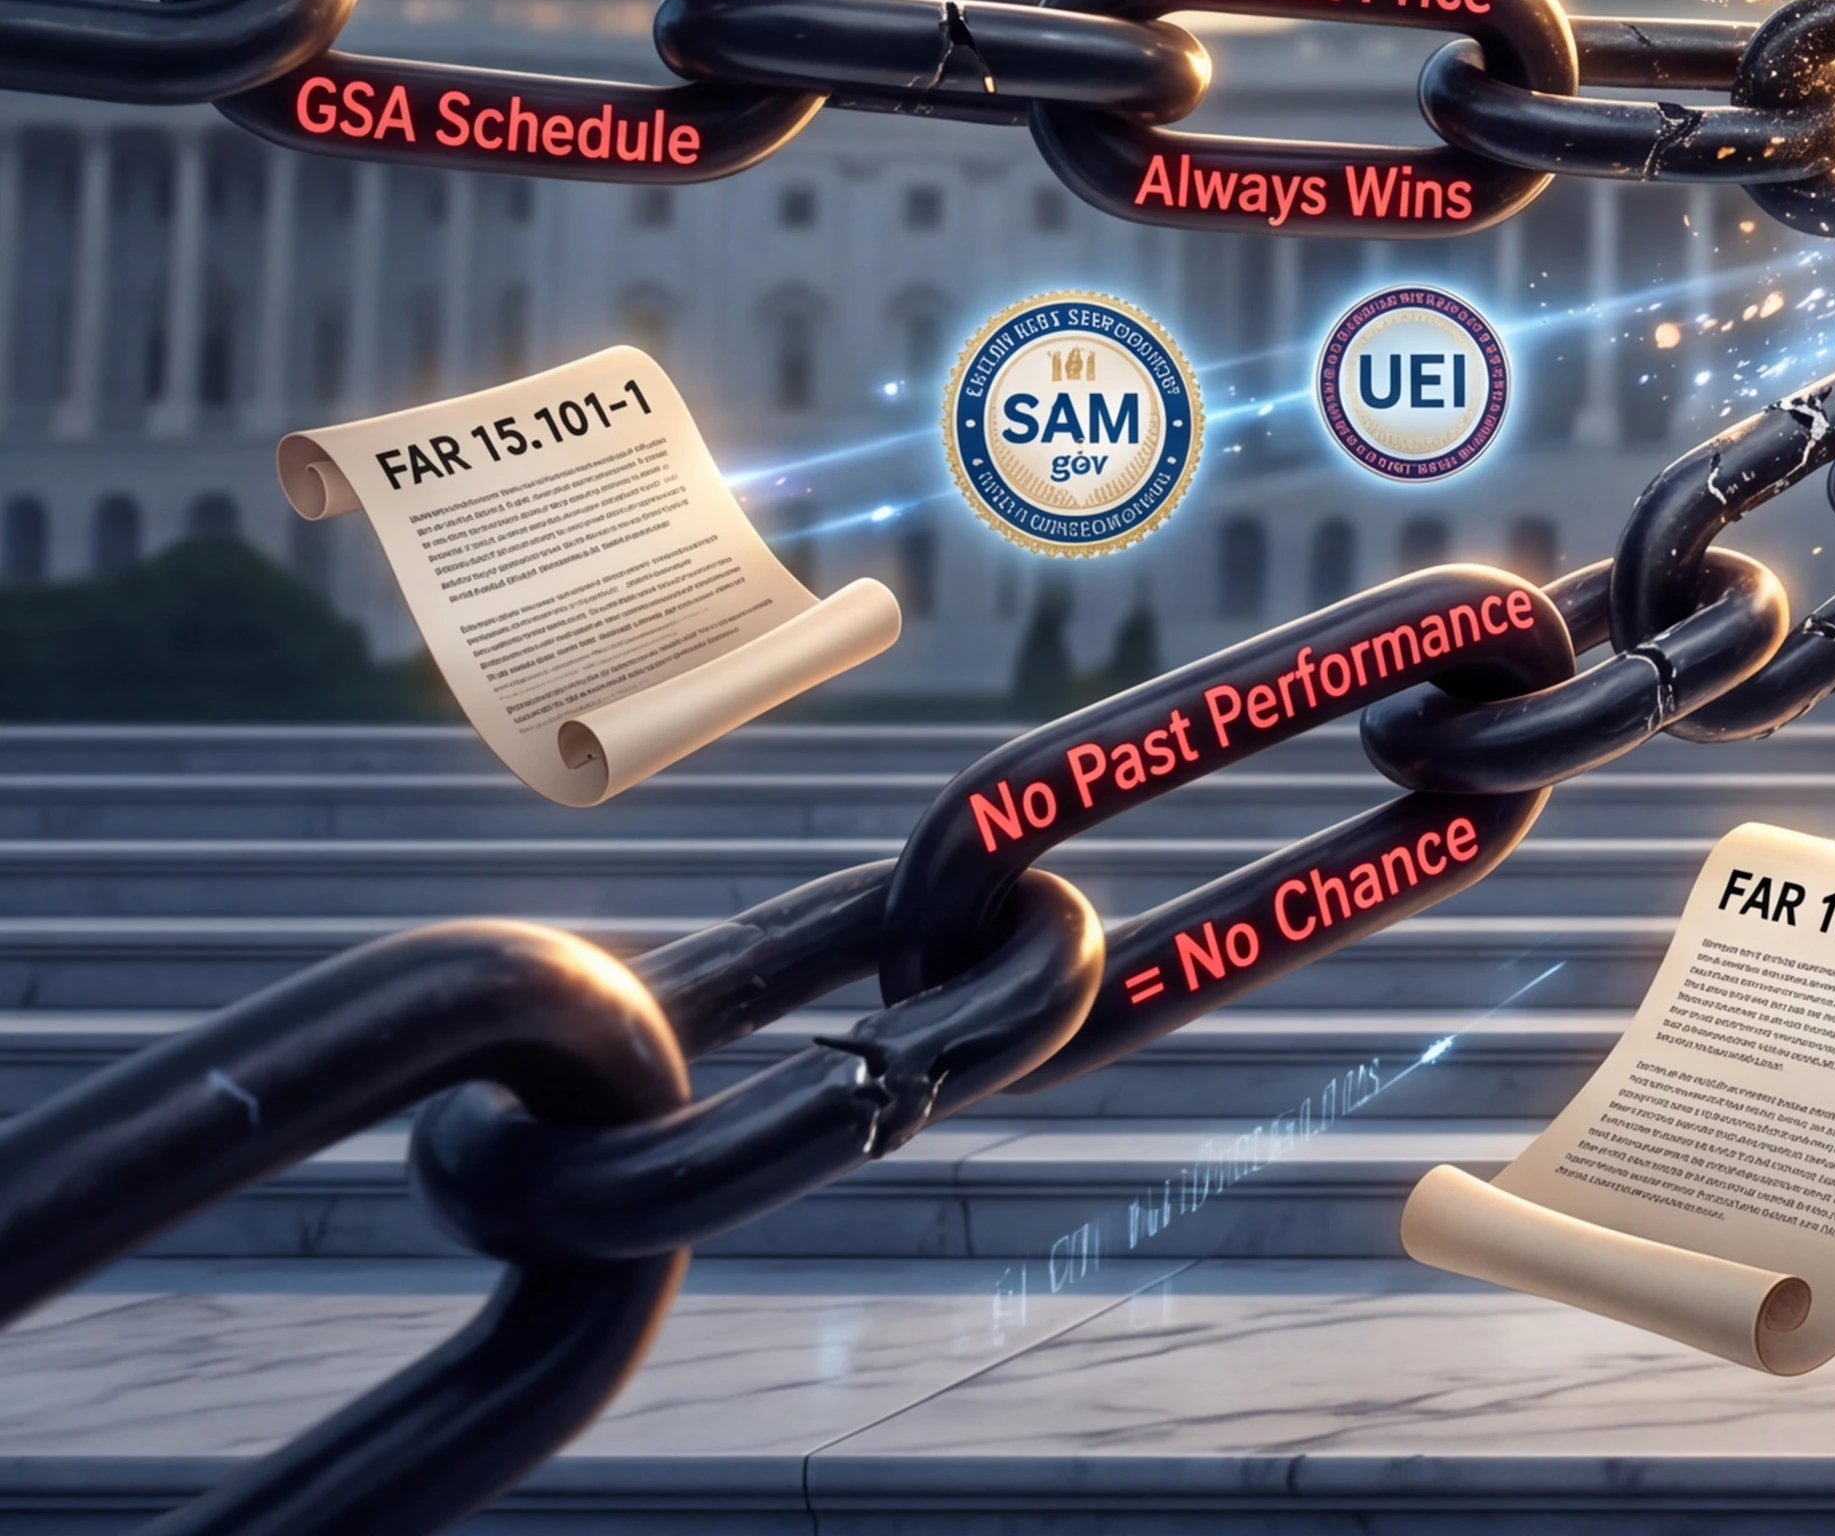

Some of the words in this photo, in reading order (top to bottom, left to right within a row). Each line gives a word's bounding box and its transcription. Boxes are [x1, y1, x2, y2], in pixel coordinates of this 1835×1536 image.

[297, 77, 415, 141] GSA
[436, 91, 699, 164] Schedule
[1135, 155, 1326, 226] Always
[1346, 166, 1471, 219] Wins
[1002, 393, 1139, 444] SAM
[1359, 354, 1465, 409] UEI
[375, 434, 472, 490] FAR
[470, 379, 652, 463] 15.101-1
[970, 781, 1056, 852] No
[1067, 710, 1199, 807] Past
[1205, 589, 1534, 747] Performance
[1126, 967, 1163, 1003] =
[1175, 922, 1259, 990] No
[1275, 818, 1478, 940] Chance
[1718, 869, 1806, 927] FAR
